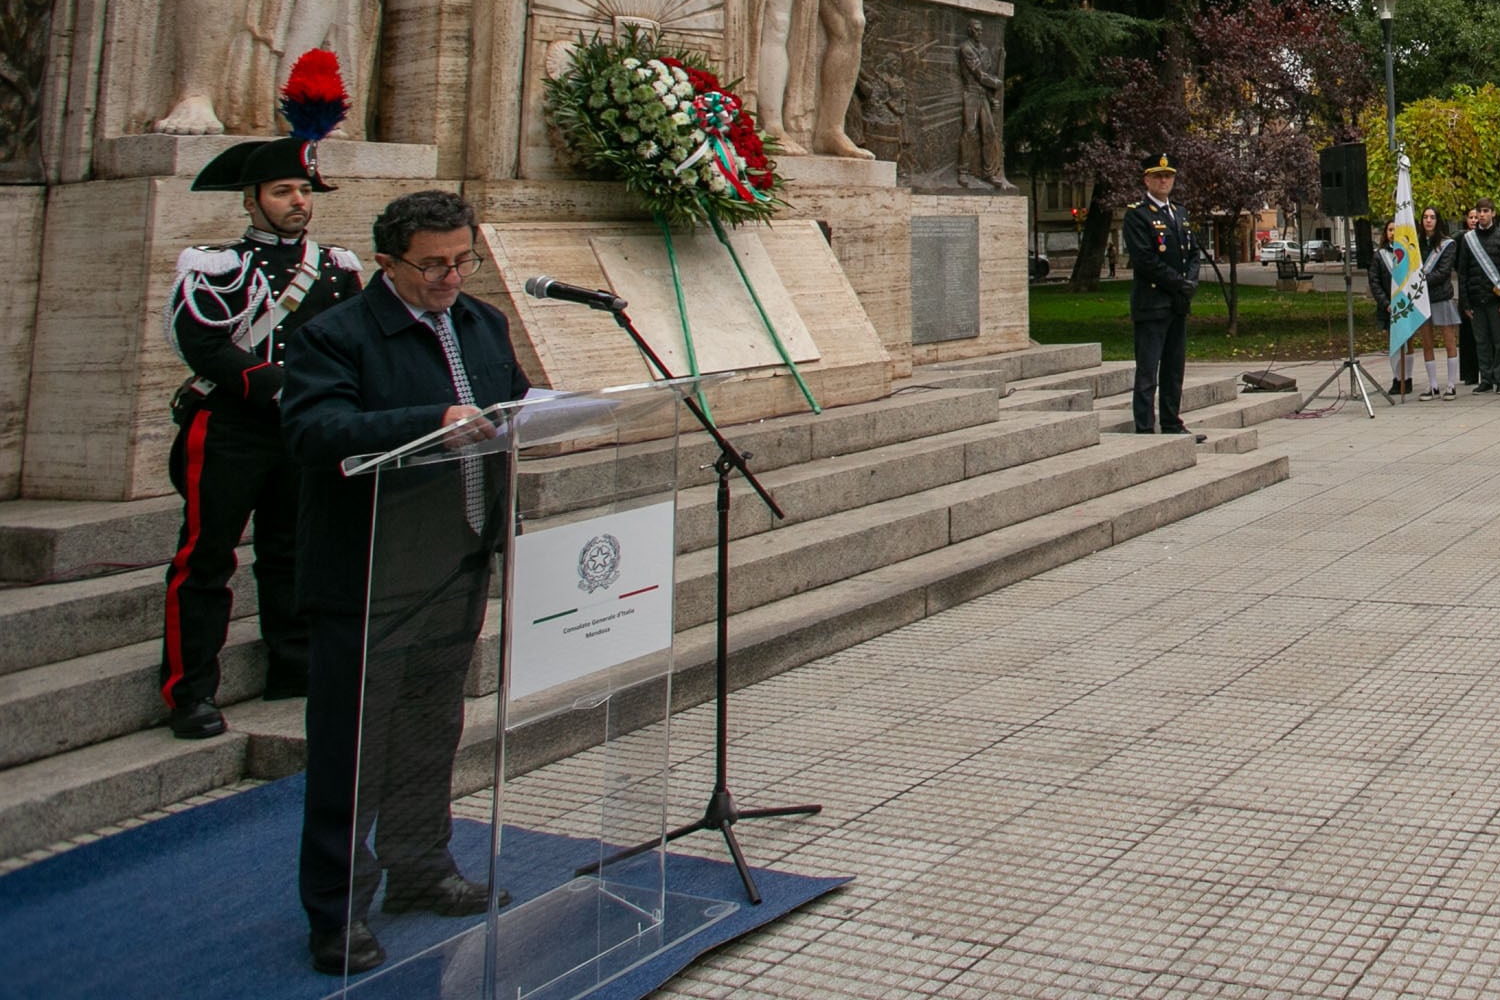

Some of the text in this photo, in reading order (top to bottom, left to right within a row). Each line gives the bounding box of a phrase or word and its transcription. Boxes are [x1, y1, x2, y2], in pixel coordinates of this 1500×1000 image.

[563, 608, 635, 634] Consulato Generale d'Italia
[585, 627, 610, 638] Mendoza
